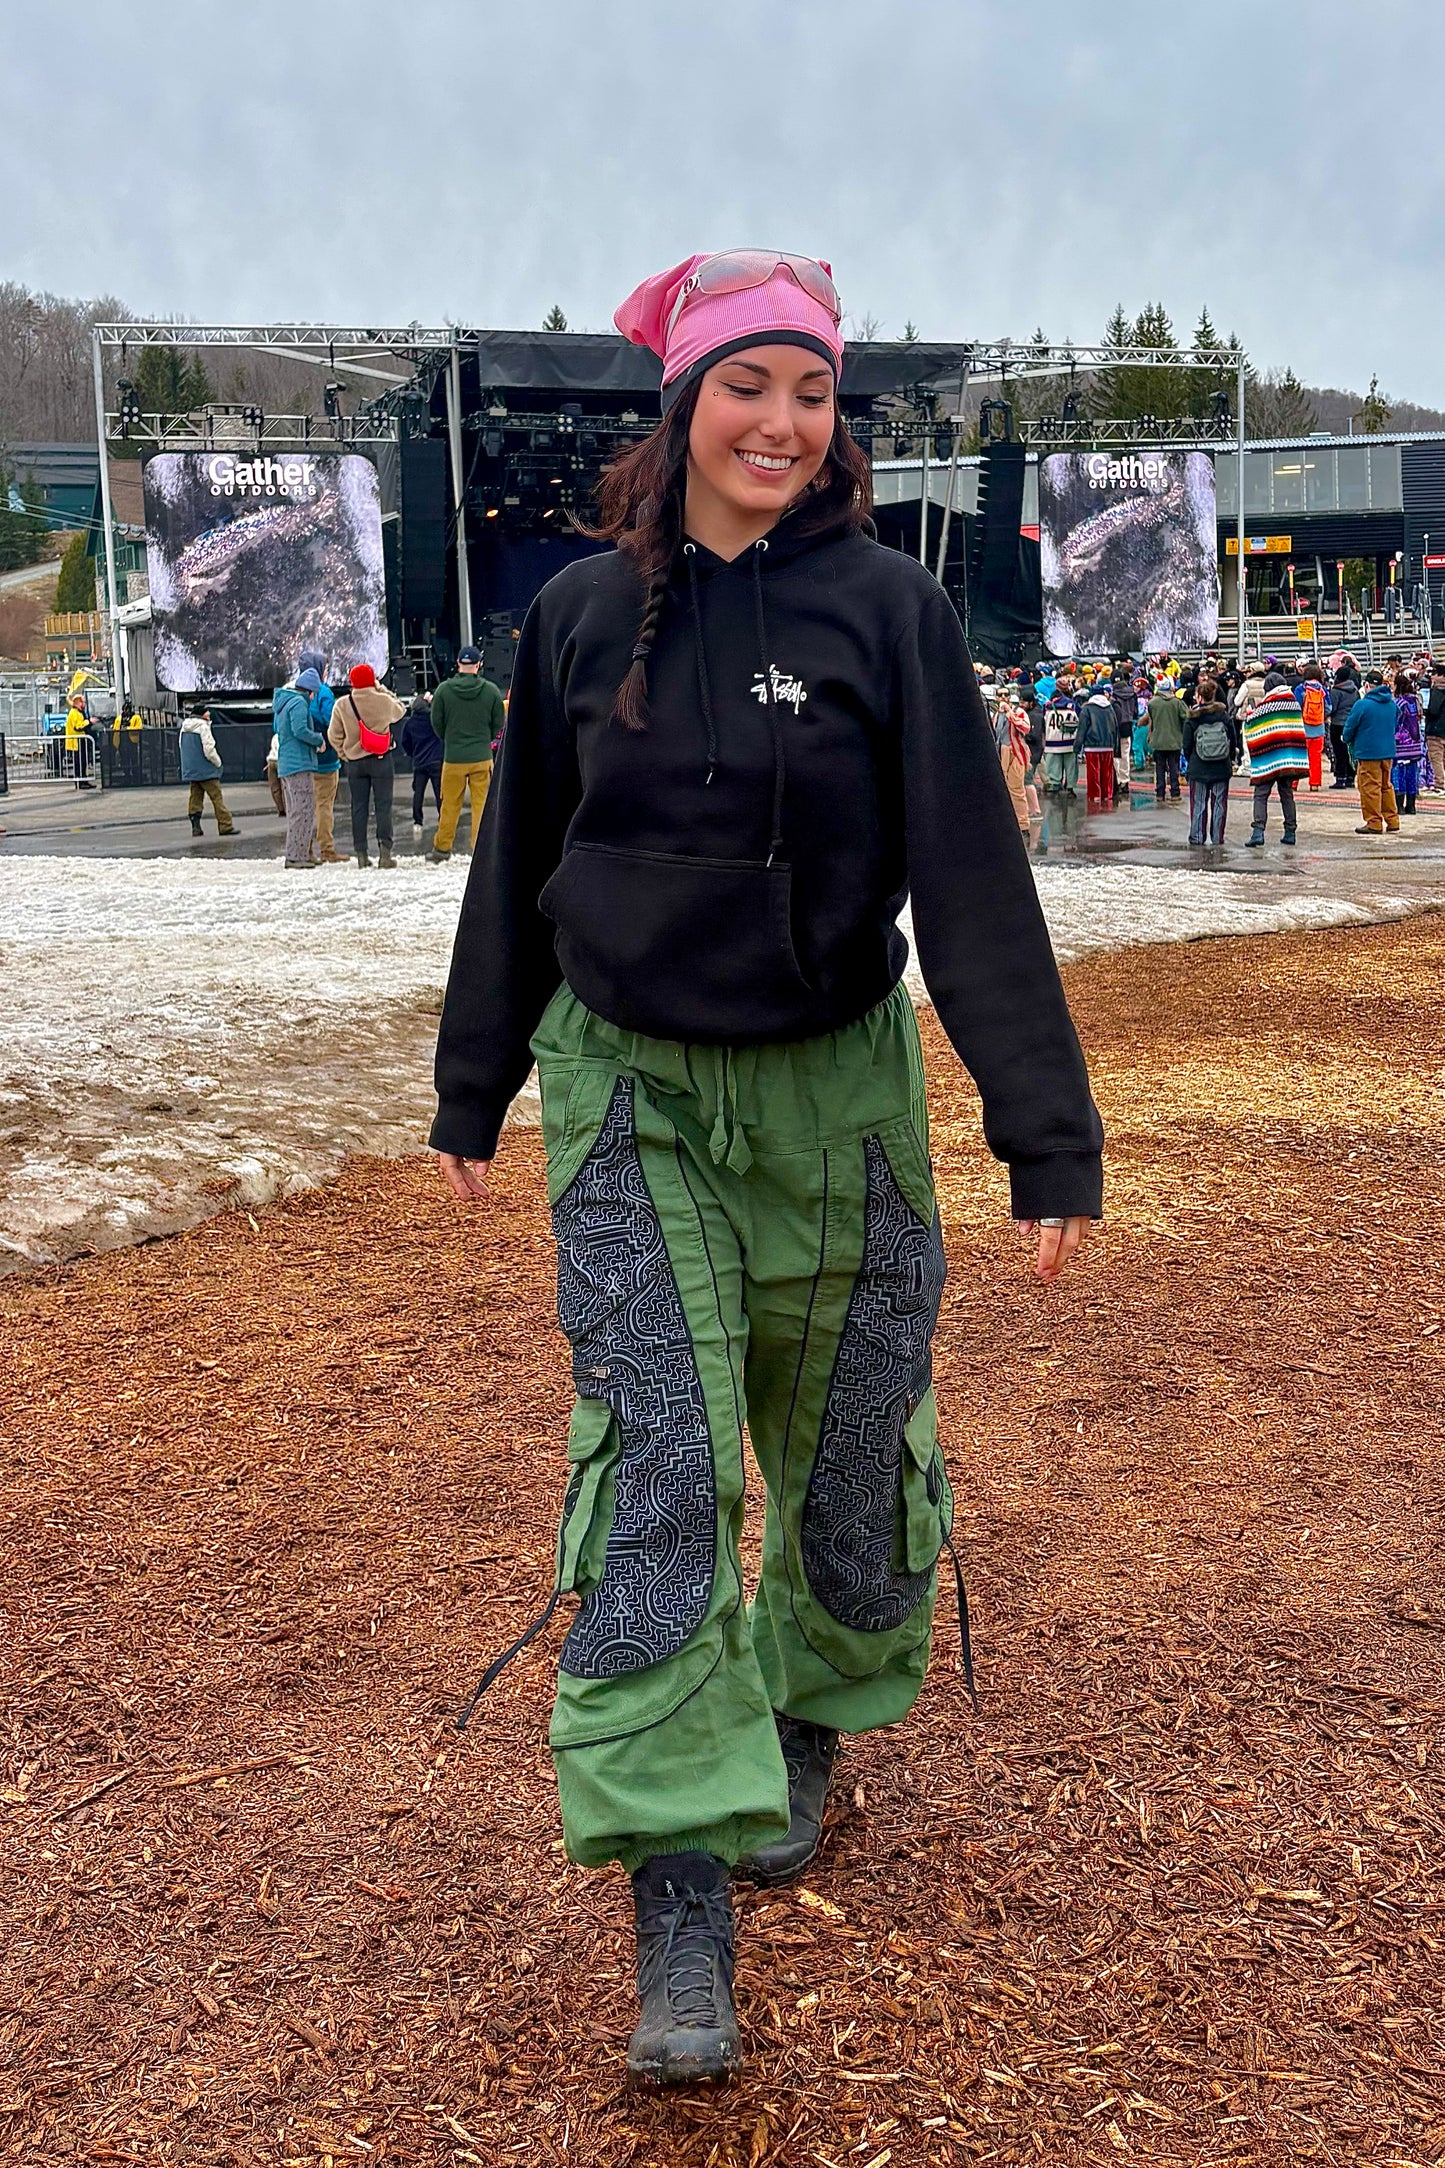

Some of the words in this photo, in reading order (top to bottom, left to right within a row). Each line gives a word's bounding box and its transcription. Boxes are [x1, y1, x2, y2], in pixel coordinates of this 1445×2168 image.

[209, 457, 315, 485] Gather
[1088, 456, 1168, 480] Gather
[210, 485, 317, 496] OUTDOORS
[1088, 479, 1169, 489] OUTDOORS
